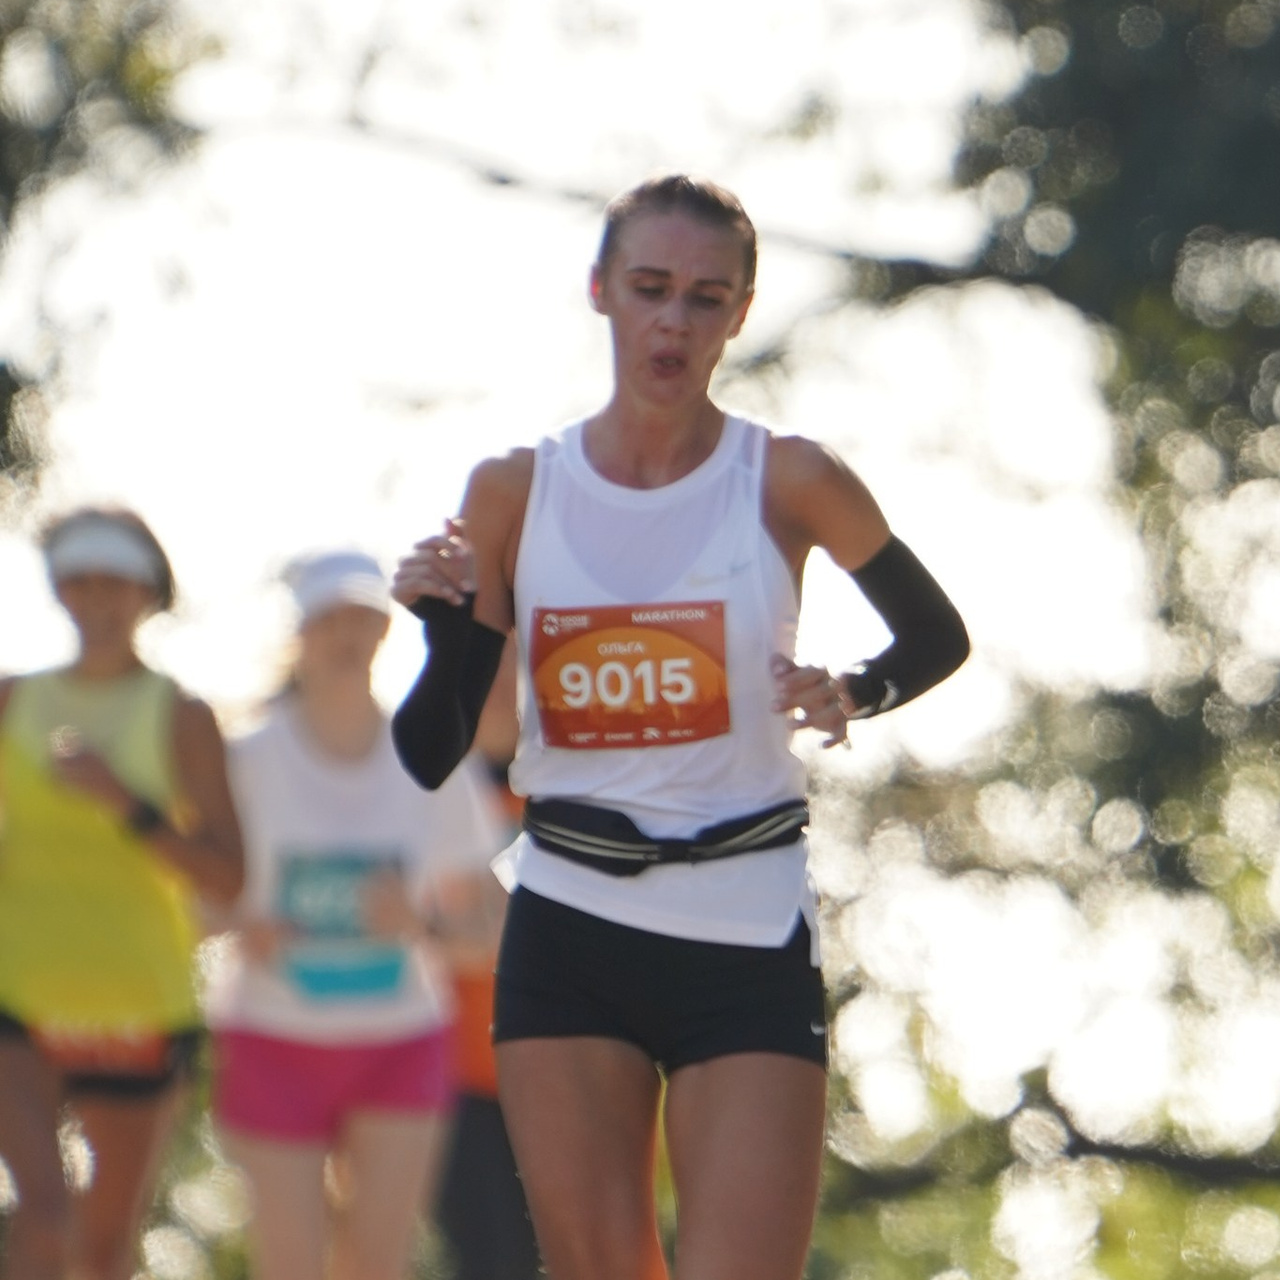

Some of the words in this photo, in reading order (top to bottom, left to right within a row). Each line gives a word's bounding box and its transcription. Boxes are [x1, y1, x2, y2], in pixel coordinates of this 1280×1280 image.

[631, 608, 706, 624] MARATHON
[596, 641, 645, 655] ОЛЬГА
[558, 658, 695, 709] 9015
